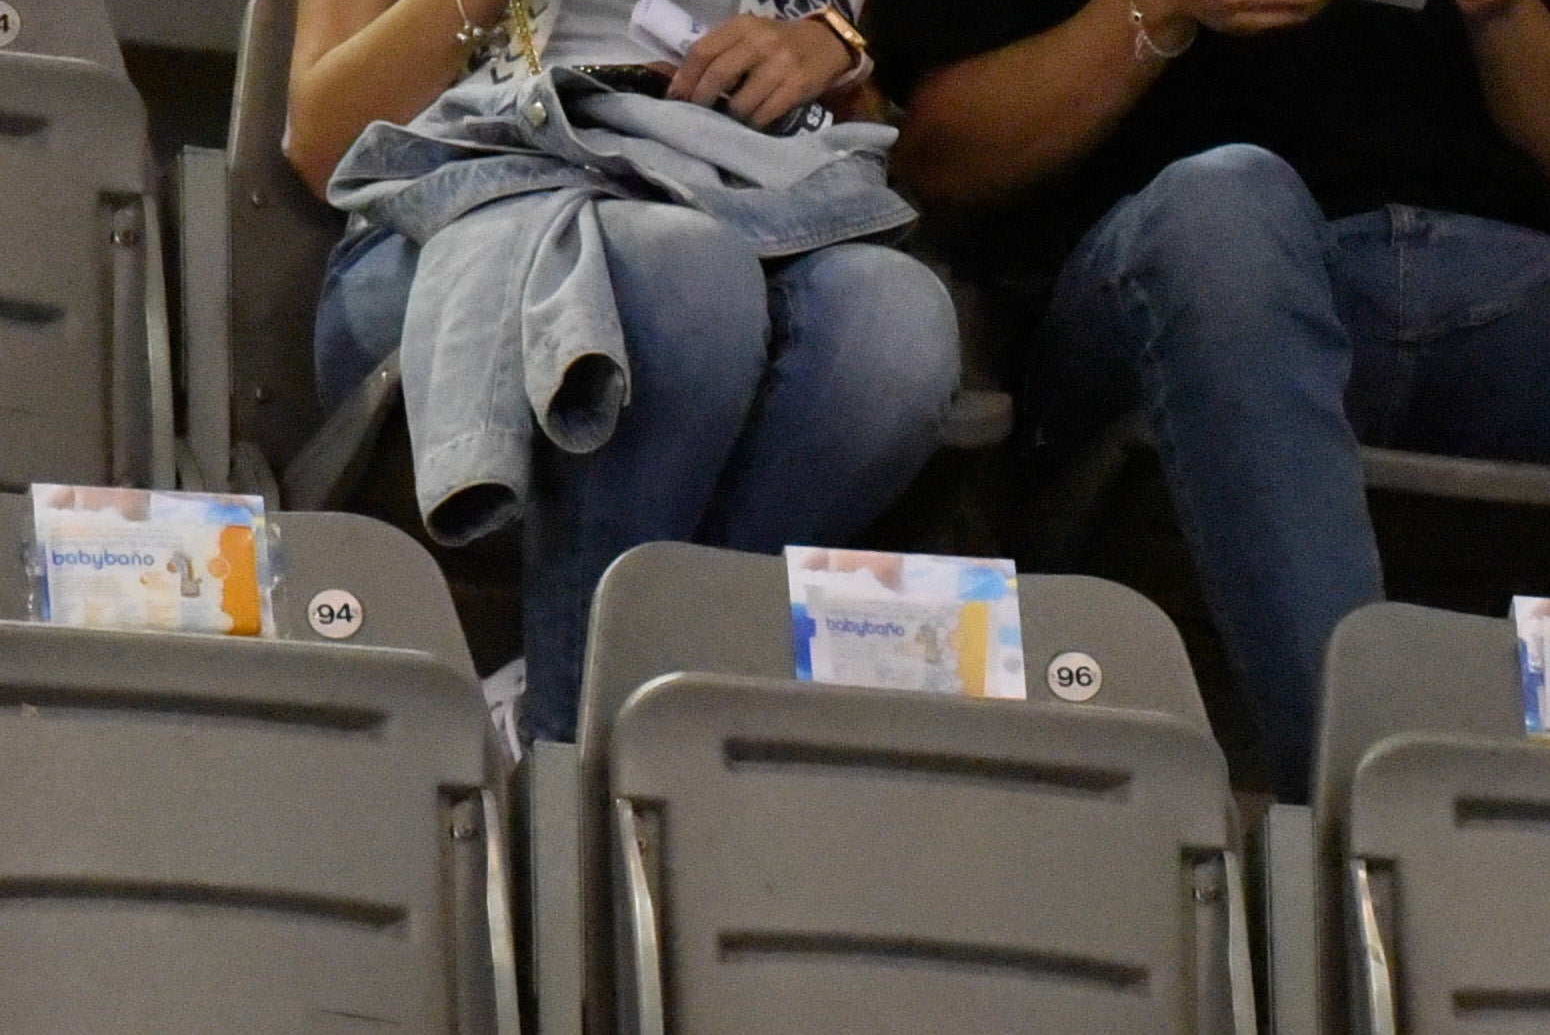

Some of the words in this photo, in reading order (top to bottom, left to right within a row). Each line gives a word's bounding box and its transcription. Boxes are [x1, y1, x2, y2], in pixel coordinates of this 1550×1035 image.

[51, 550, 155, 571] babybaño
[316, 603, 354, 625] 94
[825, 617, 905, 638] babybaño
[1056, 666, 1094, 688] 96
